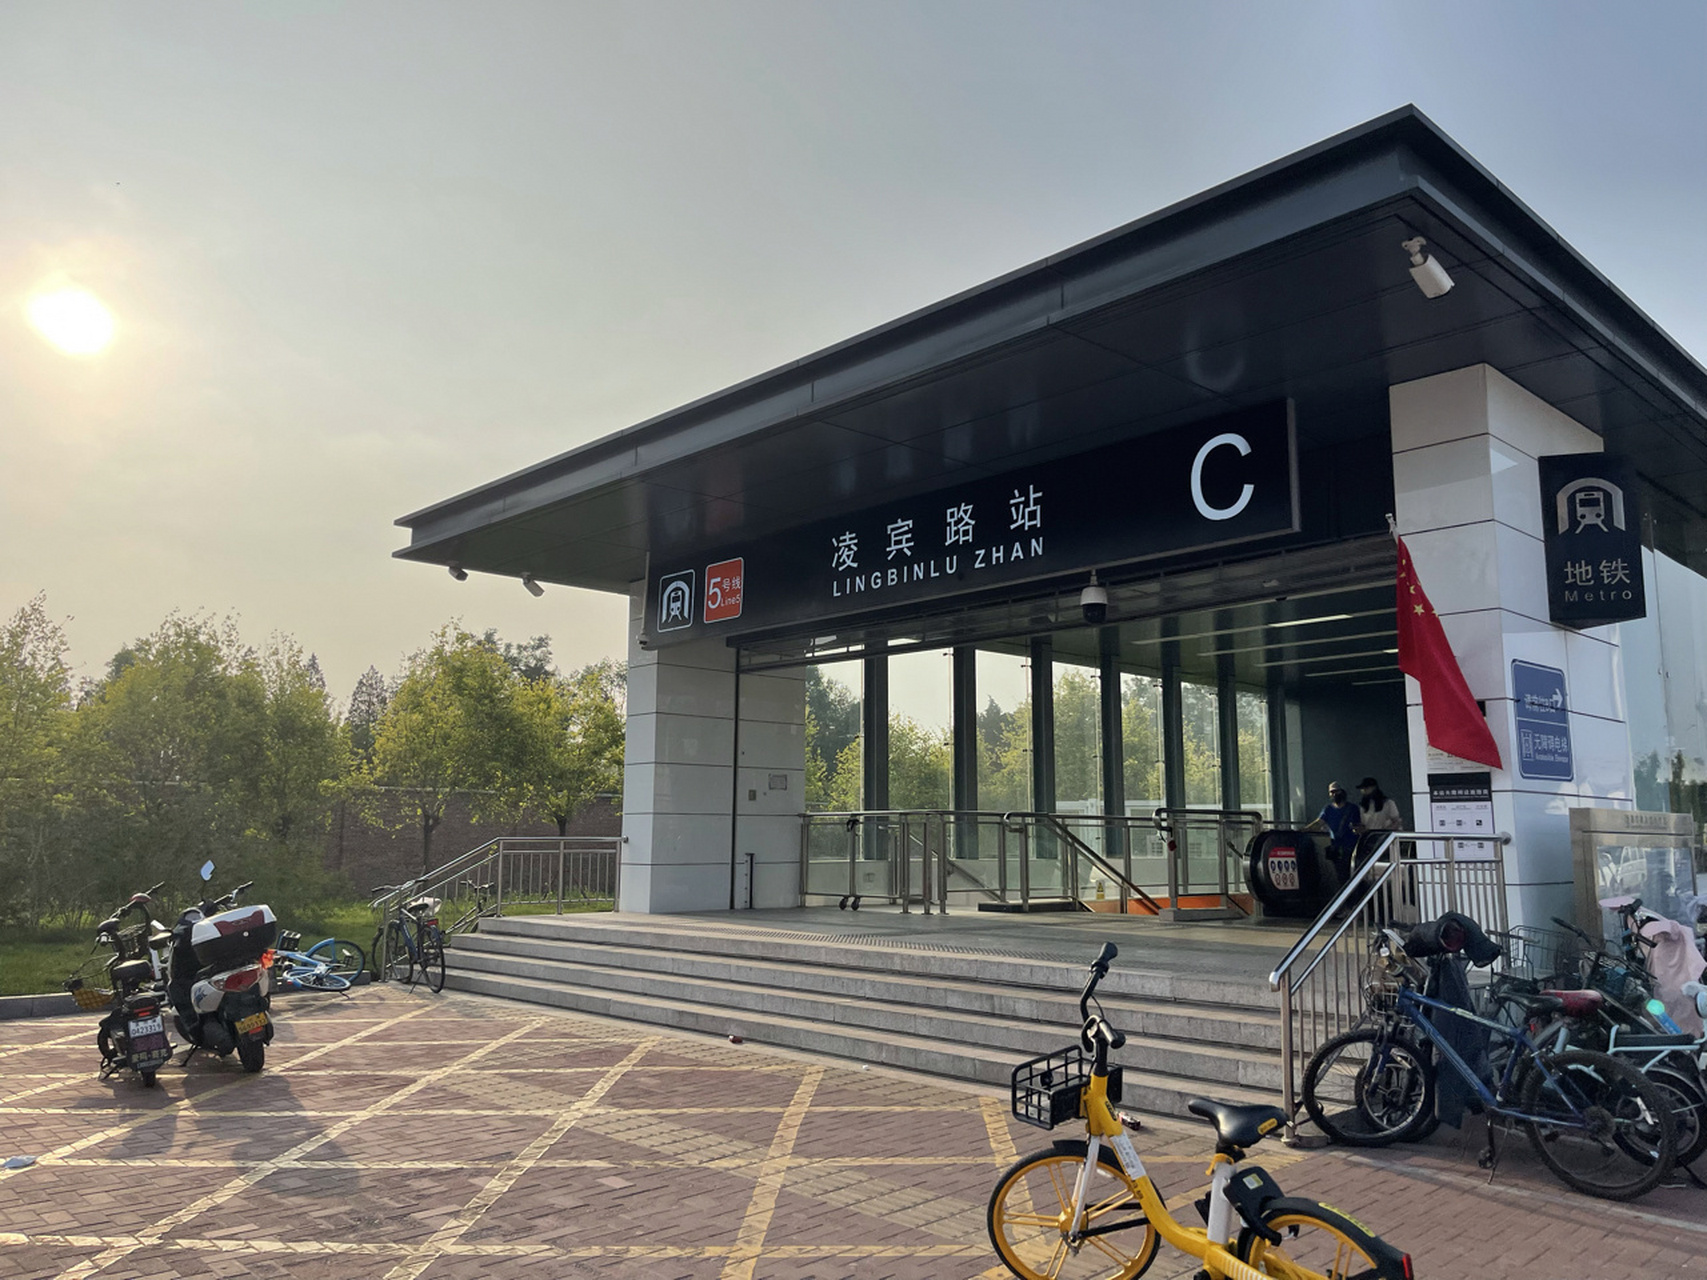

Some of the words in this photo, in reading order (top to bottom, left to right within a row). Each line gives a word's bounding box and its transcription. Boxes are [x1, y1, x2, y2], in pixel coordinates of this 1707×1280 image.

[1190, 433, 1255, 521] C
[831, 484, 1043, 572] 凌宾路站
[832, 555, 958, 598] LINGBINLU
[973, 536, 1044, 569] ZHAN
[1563, 558, 1631, 586] 地铁
[1564, 590, 1632, 602] Metro
